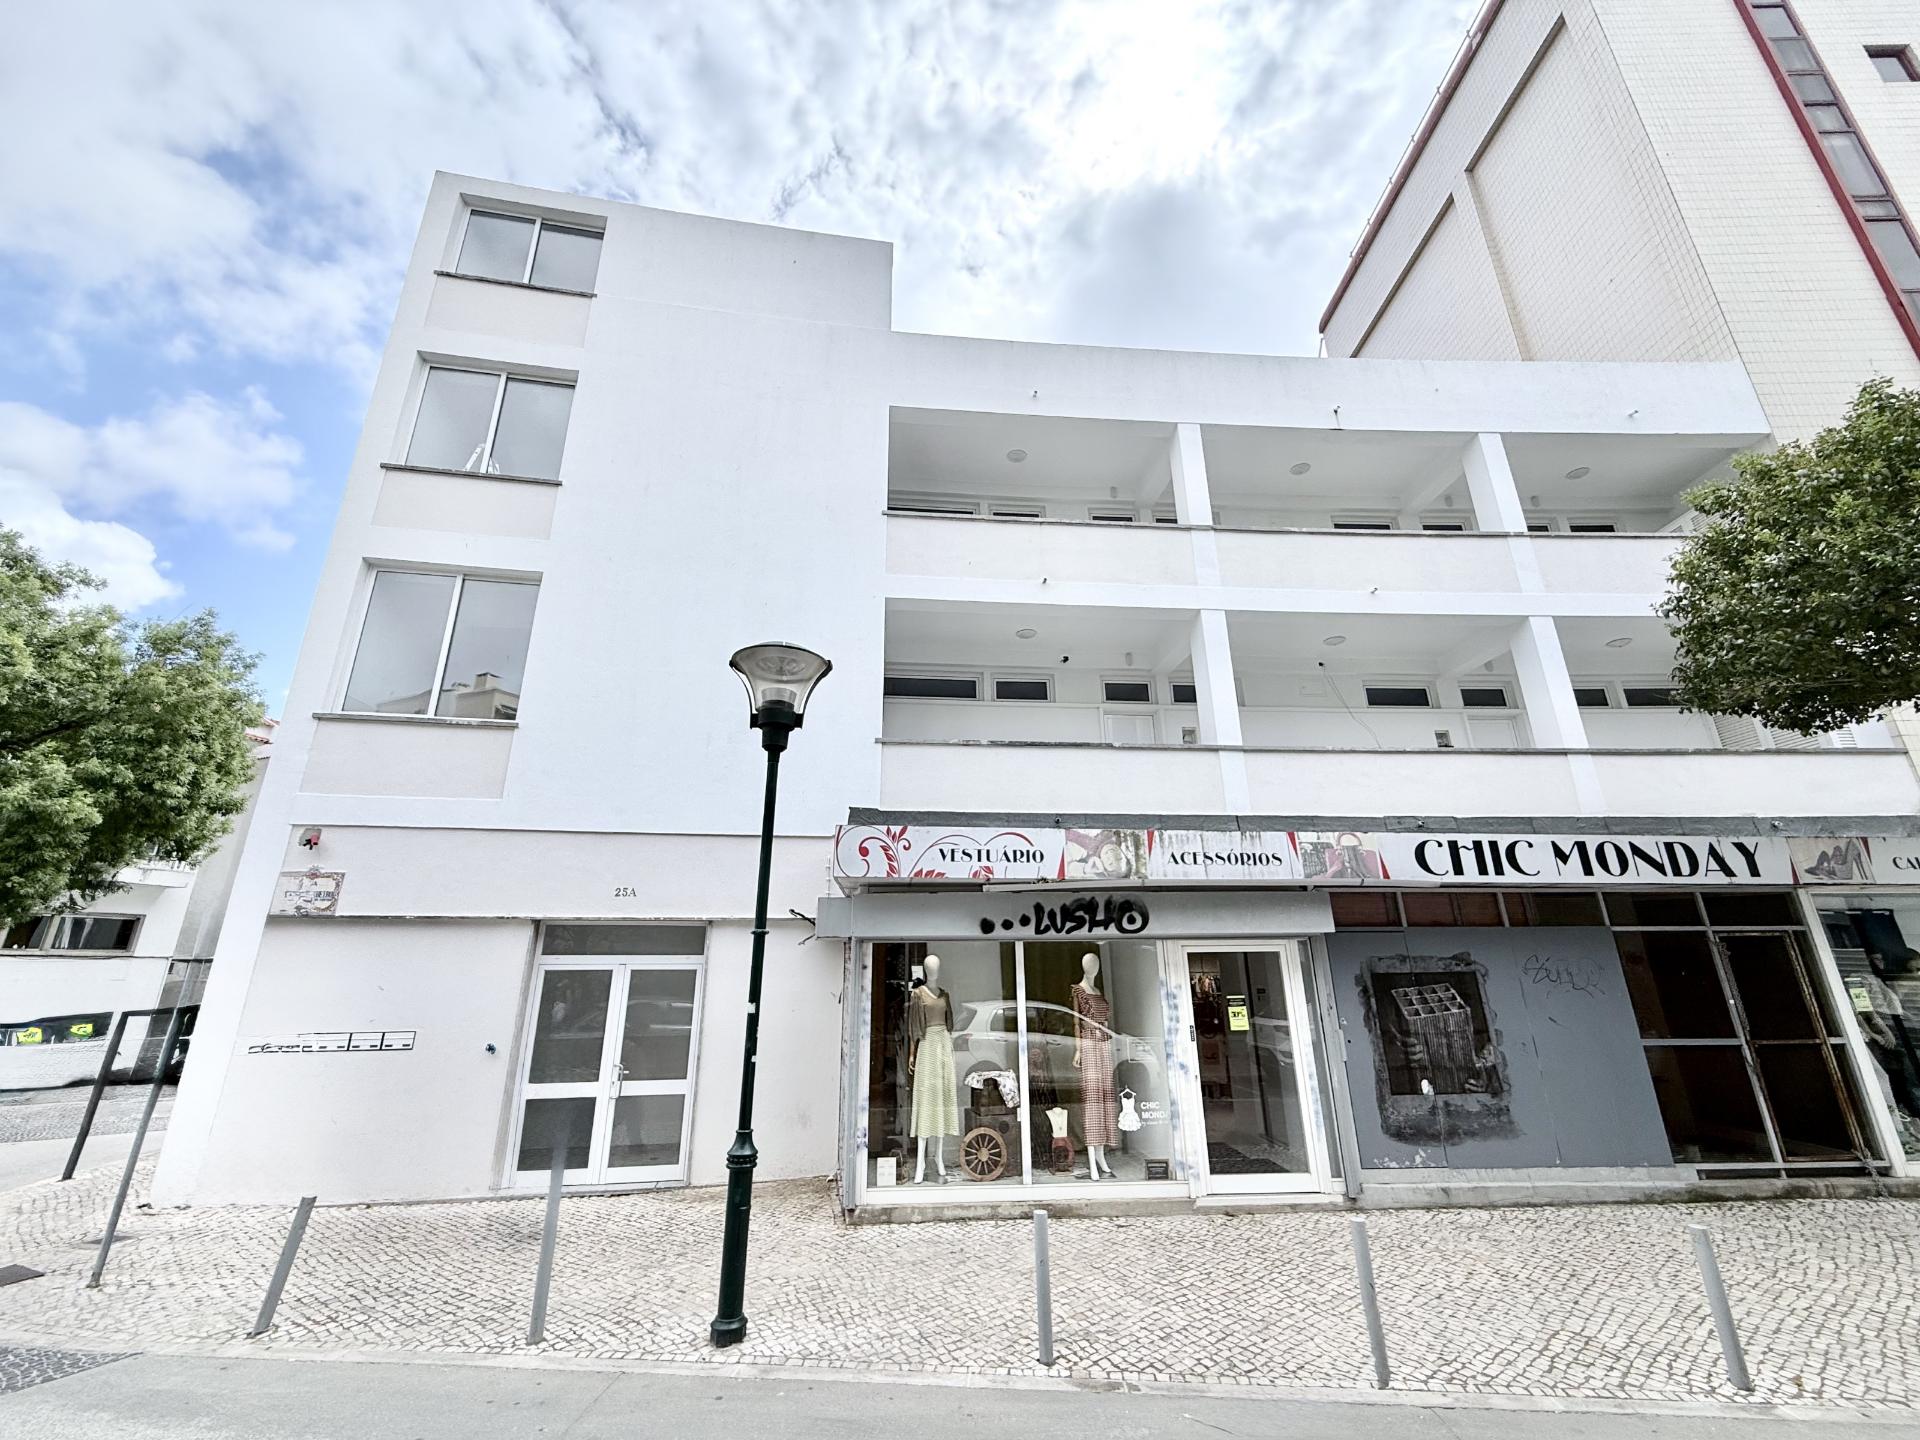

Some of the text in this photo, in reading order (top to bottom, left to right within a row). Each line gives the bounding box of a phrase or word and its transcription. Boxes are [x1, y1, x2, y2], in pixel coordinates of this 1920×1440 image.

[938, 845, 1045, 864] VESTUÁRIO
[1167, 848, 1283, 866] ACESSÓRIOS
[1414, 839, 1762, 878] CHIC MONDAY
[614, 887, 637, 897] 25A
